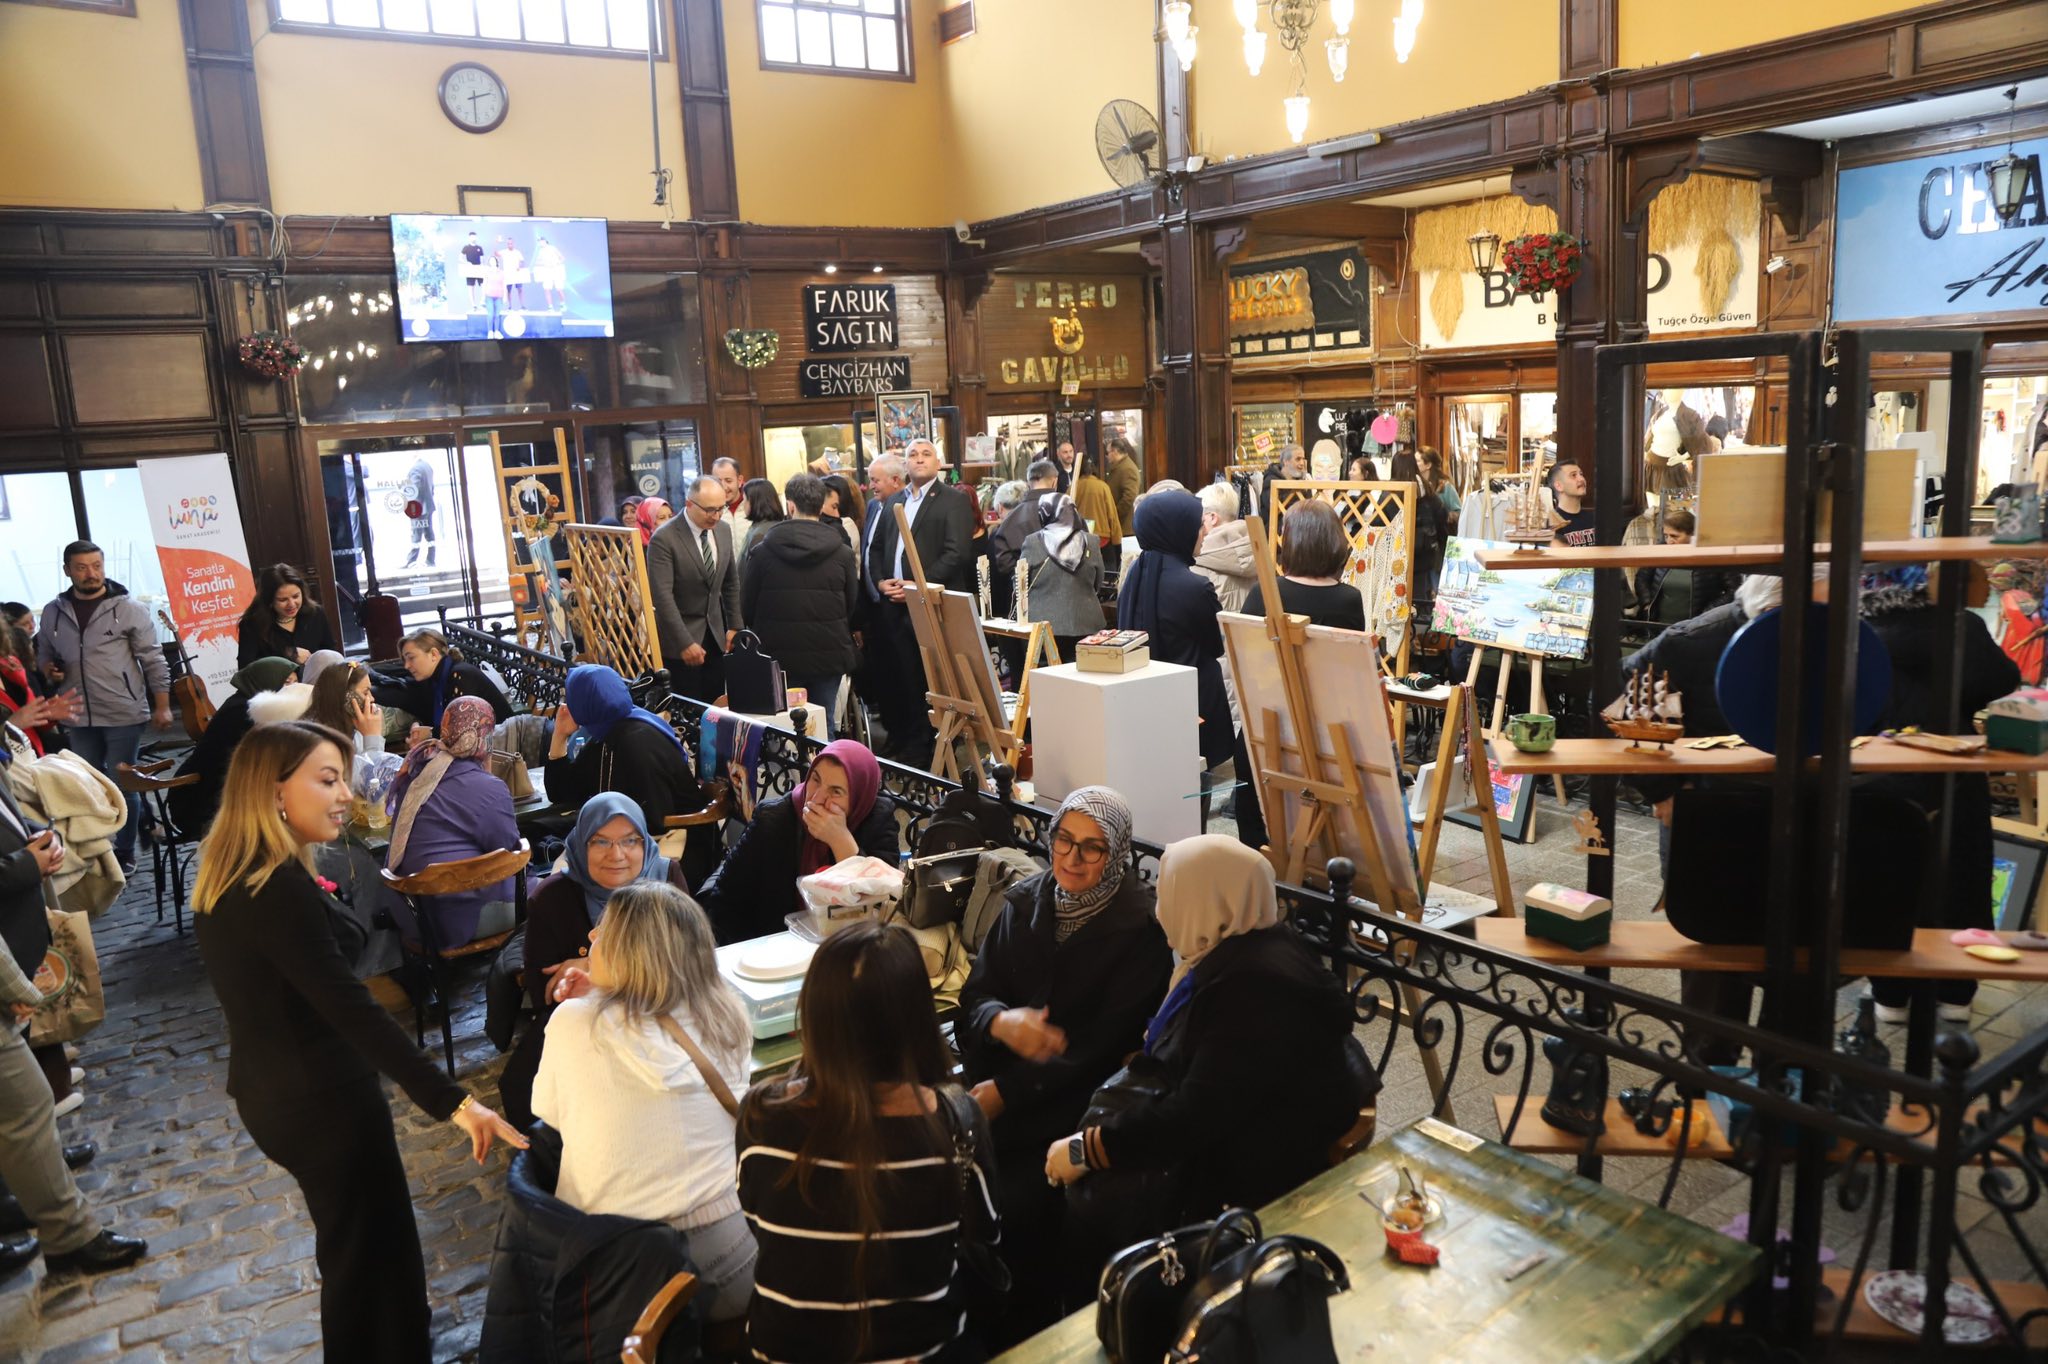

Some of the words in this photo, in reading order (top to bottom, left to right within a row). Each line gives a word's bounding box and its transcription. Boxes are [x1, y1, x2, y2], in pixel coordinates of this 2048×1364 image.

[1943, 236, 2048, 306] An
[814, 289, 891, 314] FARUK
[1014, 281, 1117, 309] FERRO
[1657, 316, 1688, 327] Tuğçe
[1689, 313, 1717, 325] Özge
[1718, 312, 1752, 322] Güven
[816, 320, 893, 346] SAGIN
[806, 359, 906, 380] CENGİZHAN
[1001, 353, 1129, 385] CAVALLO
[821, 376, 894, 396] BAYBARS
[1564, 528, 1596, 548] UNIT
[186, 562, 226, 581] Sanatla
[182, 573, 236, 598] Kendini
[191, 593, 236, 615] Keşfet
